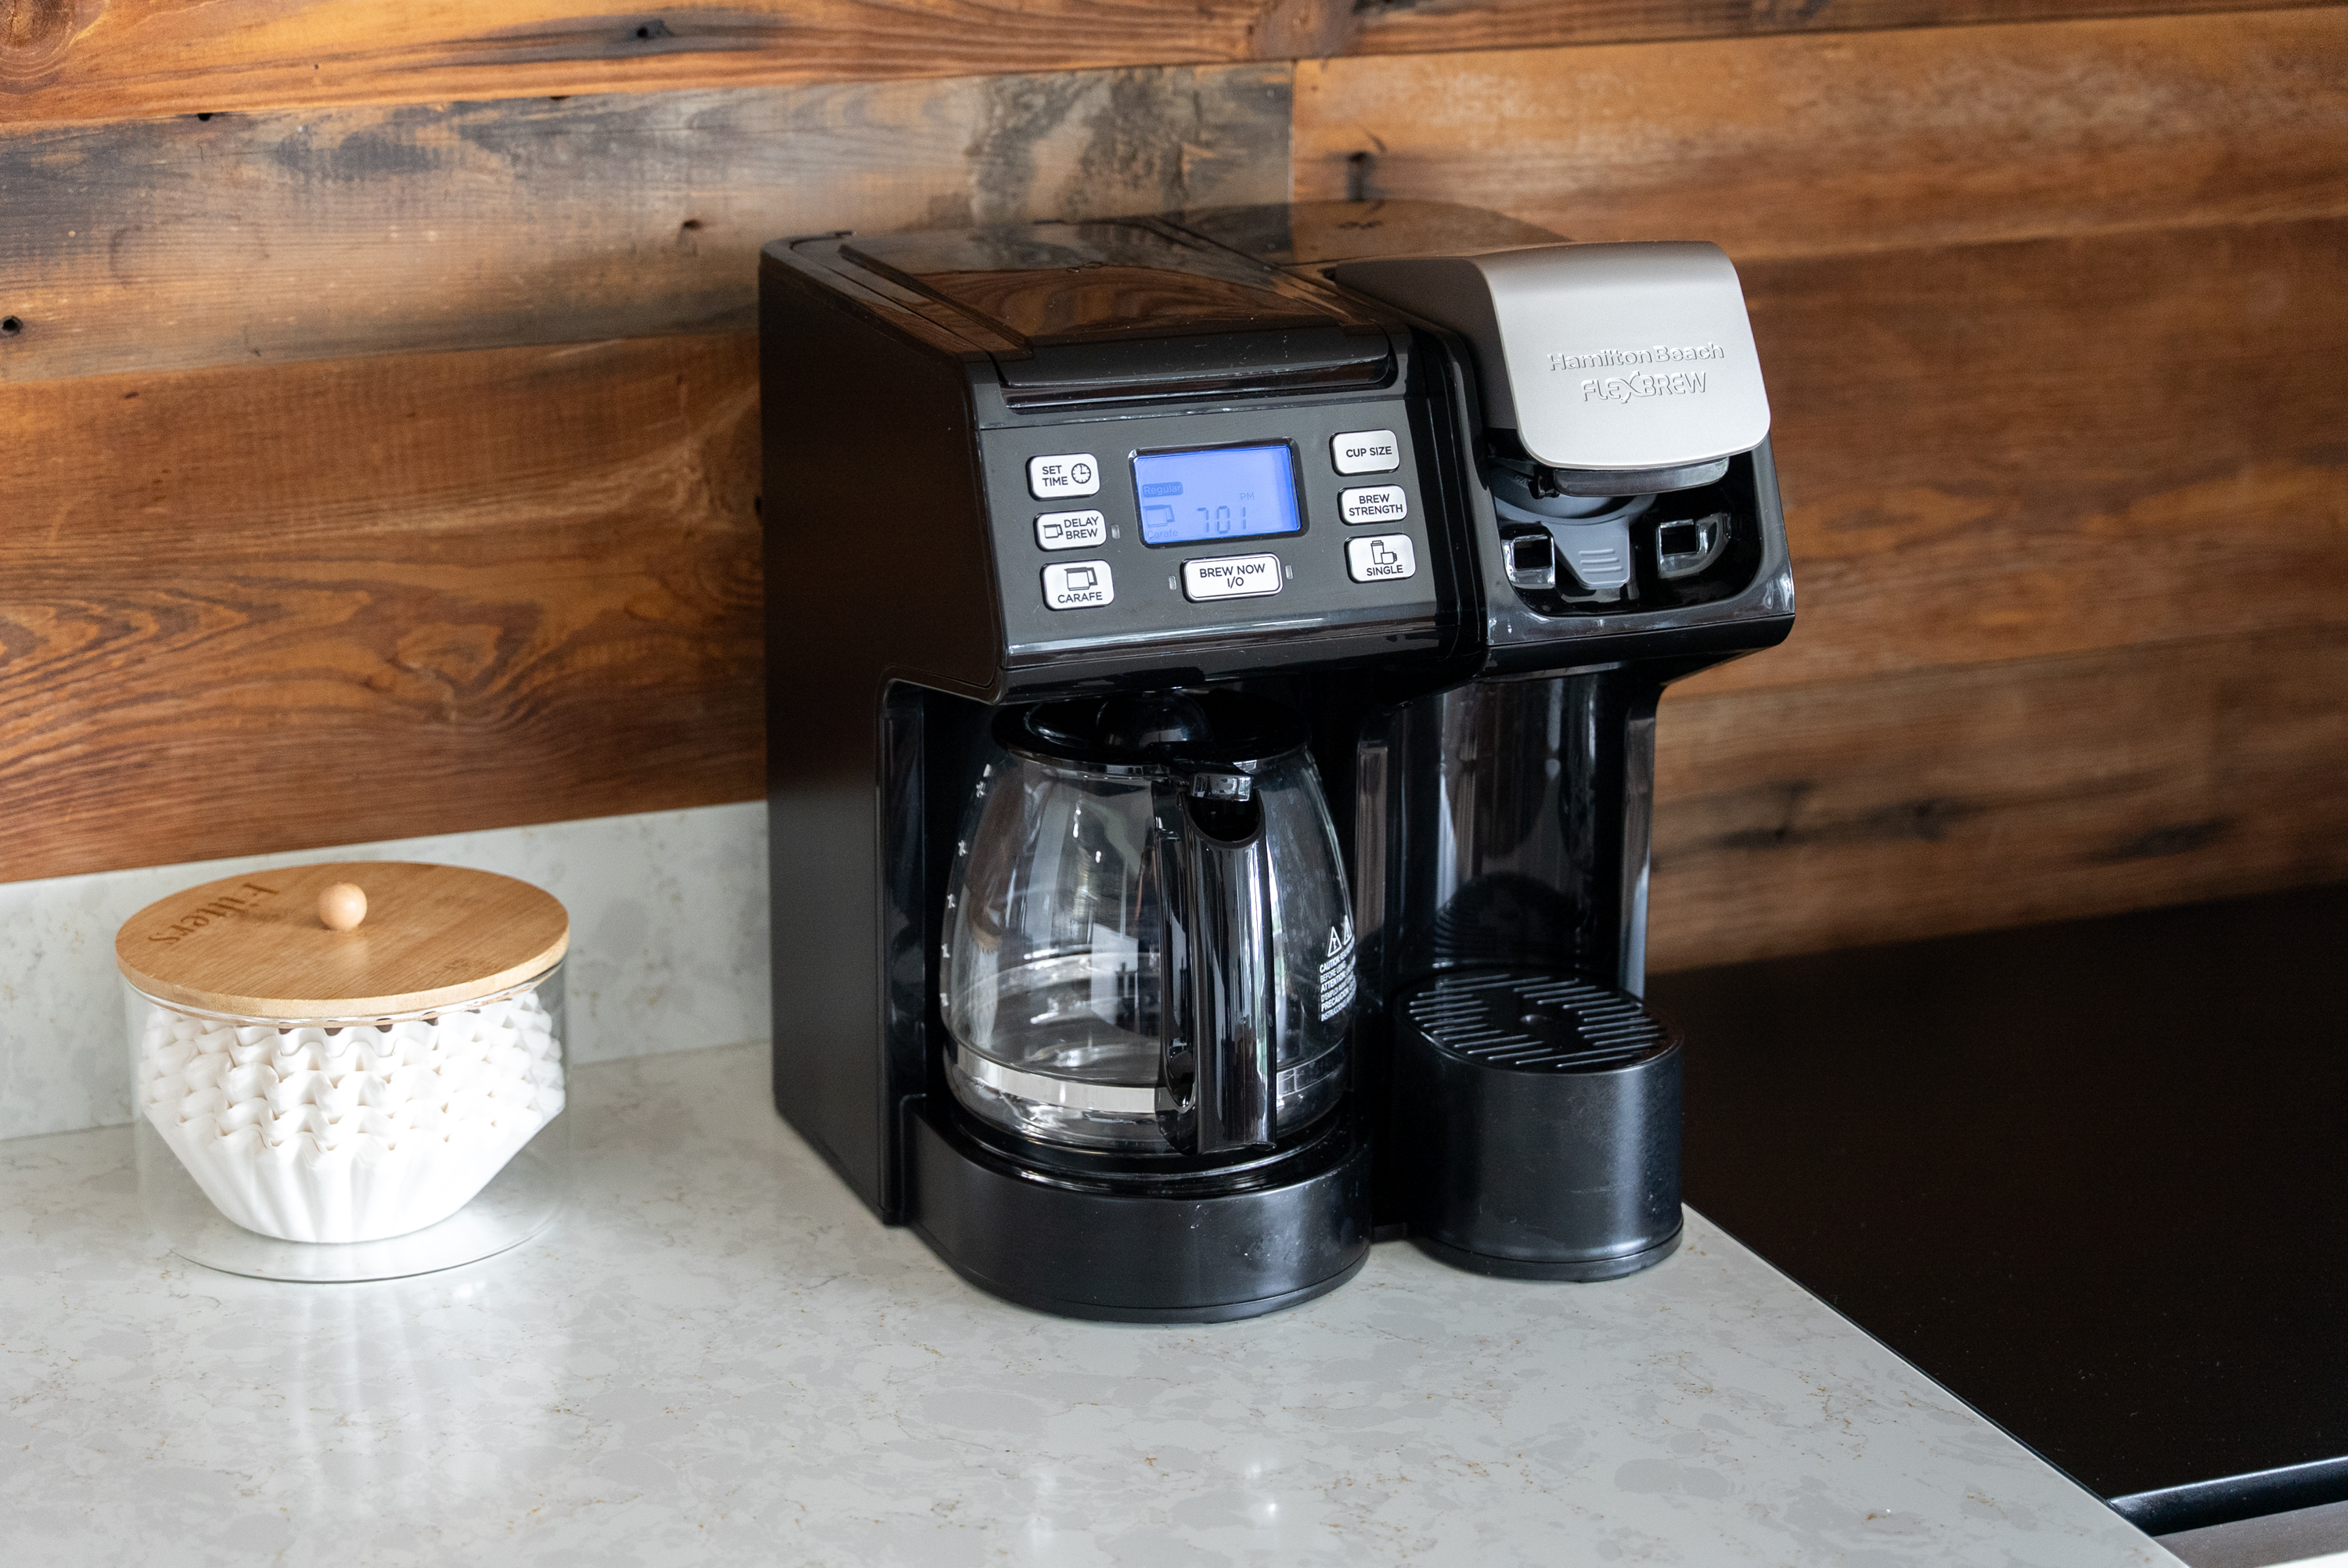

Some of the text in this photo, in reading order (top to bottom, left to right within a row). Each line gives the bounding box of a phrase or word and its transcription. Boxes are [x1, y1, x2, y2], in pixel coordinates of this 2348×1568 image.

[1547, 341, 1725, 372] Hamilton Beach
[1580, 370, 1707, 405] FLEXBREW
[1345, 446, 1392, 458] CUP SIZE
[1042, 465, 1063, 475] SET
[1042, 476, 1069, 487] TIME
[1143, 484, 1182, 495] Regular
[1240, 492, 1255, 502] PM
[1359, 493, 1390, 505] BREW
[1349, 504, 1403, 516] STRENGTH
[1064, 516, 1100, 528] DELAY
[1065, 528, 1098, 540] BREW
[1147, 528, 1179, 540] Carafe
[1199, 563, 1266, 578] BREW NOW
[1367, 564, 1404, 577] SINGLE
[1226, 576, 1244, 589] I/O
[1057, 592, 1104, 604] CARAFE
[147, 882, 281, 946] Filters
